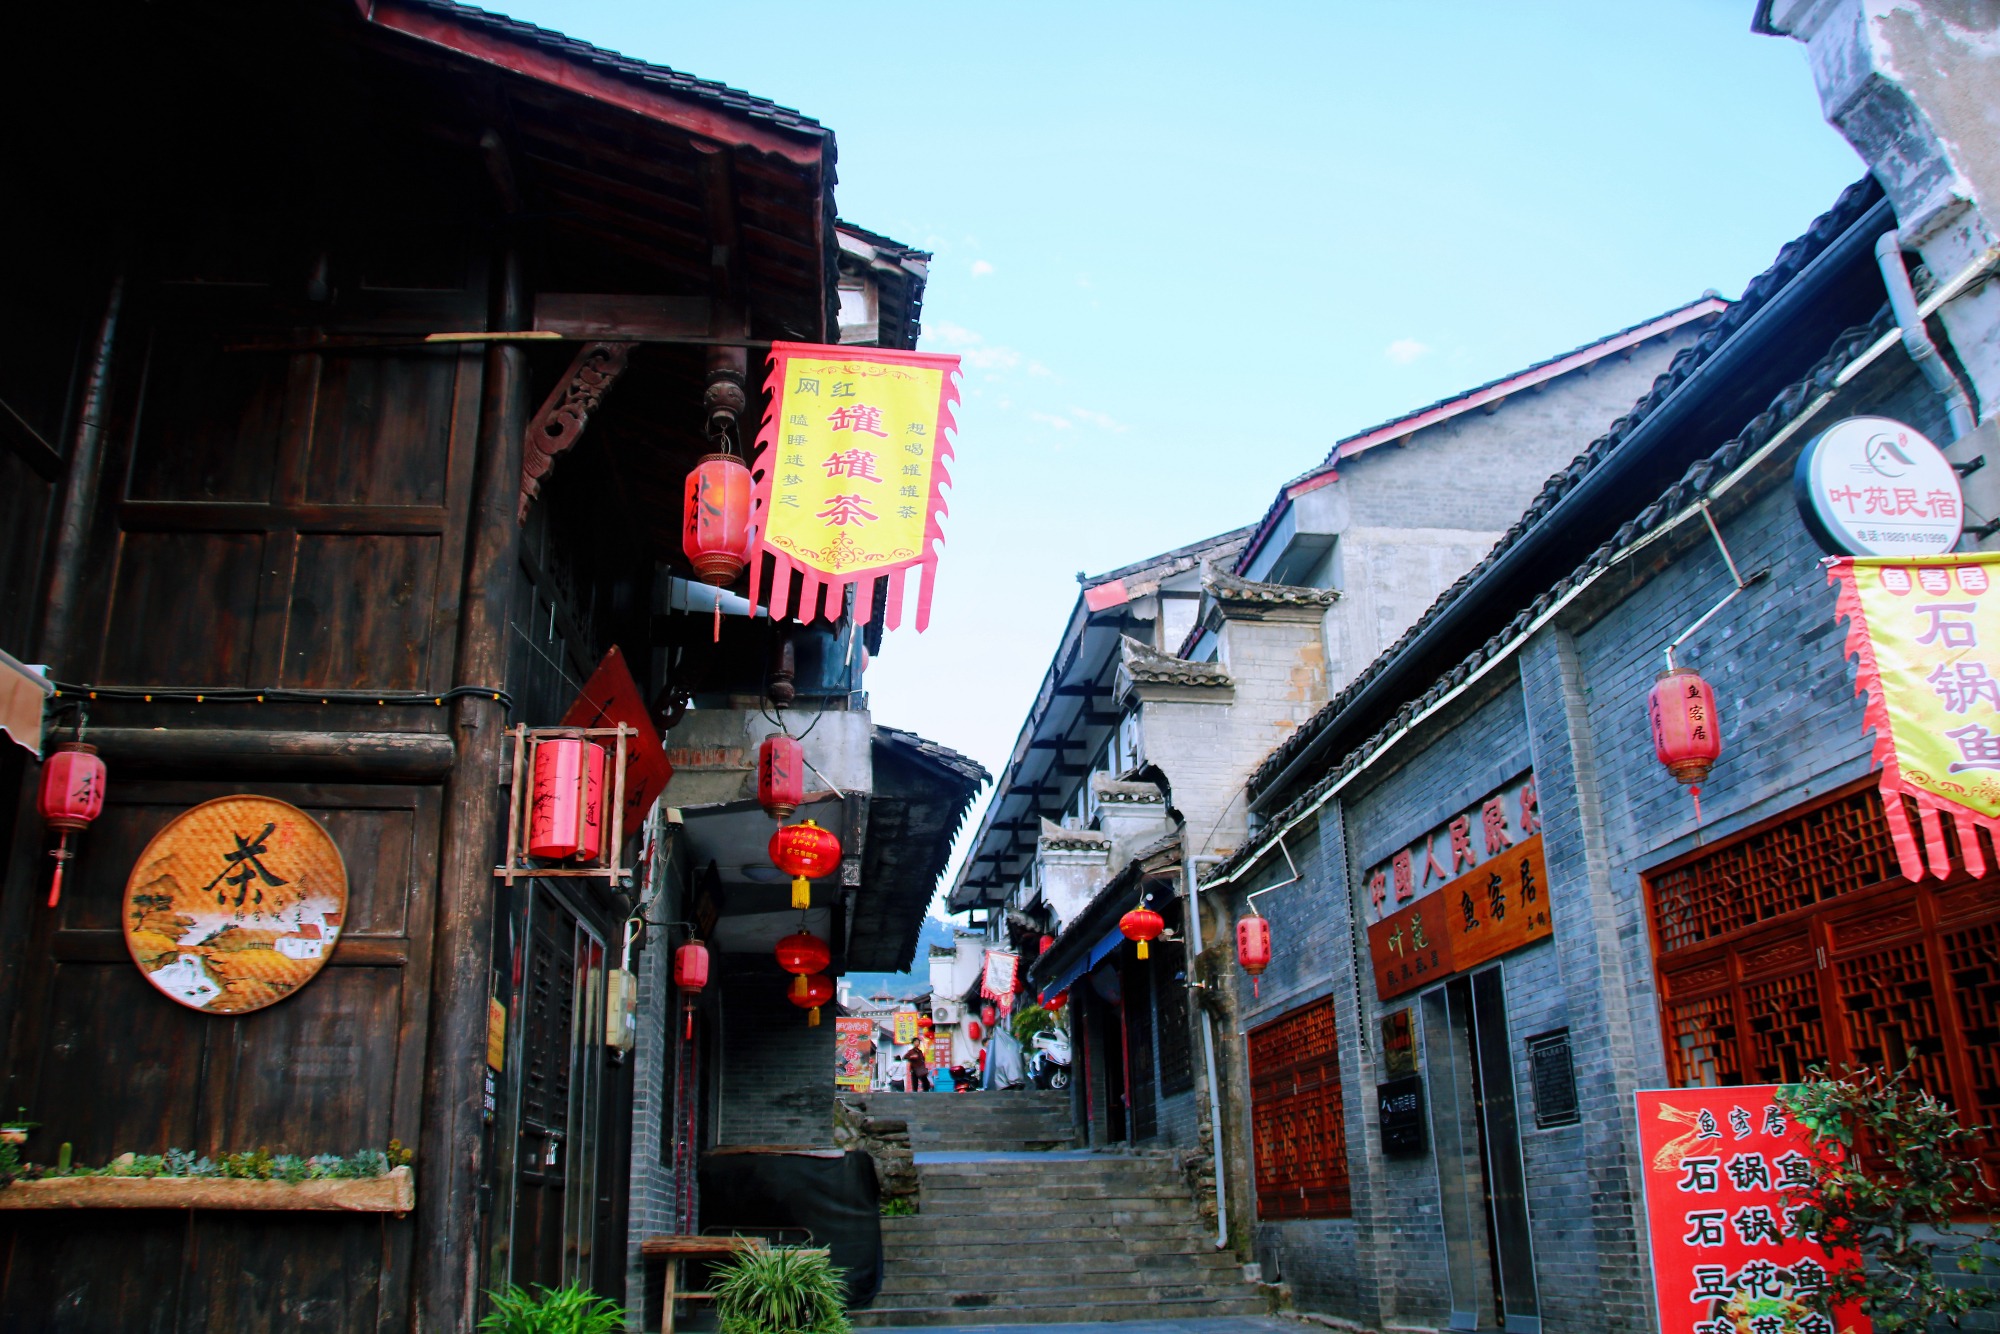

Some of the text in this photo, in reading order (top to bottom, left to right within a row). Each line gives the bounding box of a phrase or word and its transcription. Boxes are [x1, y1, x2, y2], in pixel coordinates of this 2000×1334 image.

[794, 377, 856, 397] 网红
[816, 403, 889, 528] 罐罐茶
[896, 422, 927, 520] 想喝罐罐茶
[1829, 484, 1957, 518] 叶苑民宿
[1915, 601, 2000, 774] 石锅鱼
[1687, 685, 1706, 741] 鱼客居
[763, 748, 789, 788] 茶
[202, 822, 289, 907] 茶
[1697, 1106, 1787, 1139] 鱼客居
[1678, 1151, 1818, 1192] 石锅鱼
[1692, 1260, 1832, 1302] 豆花鱼
